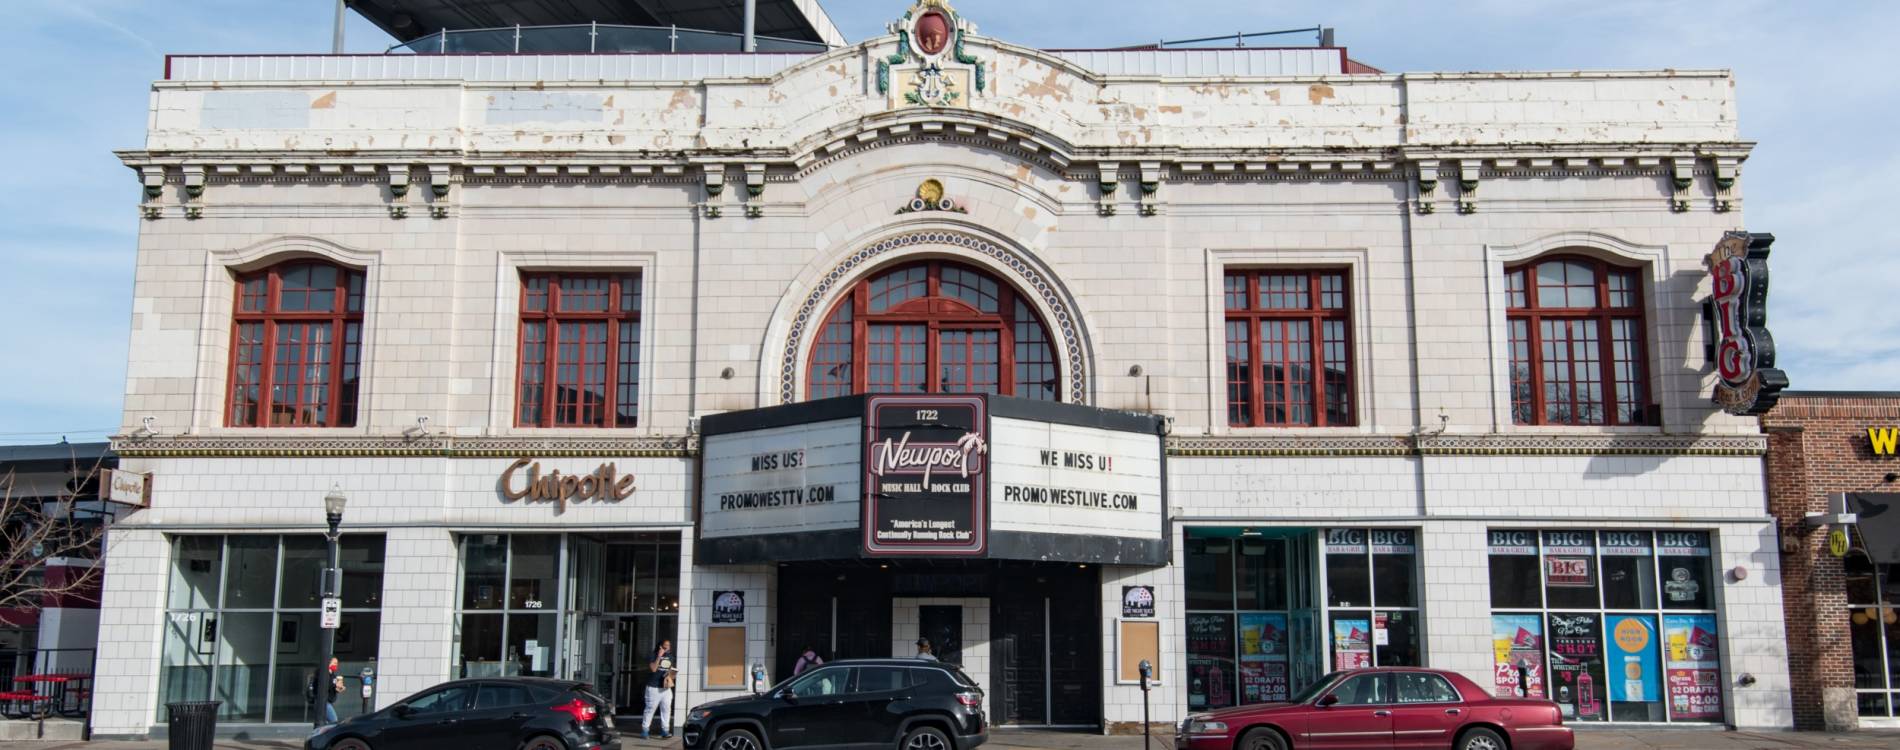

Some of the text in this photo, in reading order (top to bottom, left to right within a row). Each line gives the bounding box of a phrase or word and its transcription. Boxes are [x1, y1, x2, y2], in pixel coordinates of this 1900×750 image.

[1713, 260, 1744, 380] BIG
[916, 410, 938, 420] 1722
[752, 452, 804, 471] MISS US?
[878, 431, 987, 490] Newport
[1040, 449, 1112, 471] WE MISS U!
[114, 476, 142, 496] Chipotle
[502, 457, 637, 514] Chipotle
[882, 483, 970, 493] MUSIC HALL ROCK CLUB
[720, 485, 835, 510] PROMOWESTTV.COM
[929, 520, 955, 530] Longest
[939, 531, 955, 539] Rock
[1374, 531, 1408, 545] BIG
[1492, 532, 1526, 546] BIG
[1549, 532, 1583, 546] BIG
[1606, 532, 1640, 546] BIG
[1664, 533, 1698, 546] BIG
[1553, 561, 1584, 574] BIG
[525, 600, 542, 608] 1726
[170, 613, 197, 622] 1726
[1556, 644, 1596, 653] SHOT
[1260, 685, 1286, 693] $2.00
[1683, 686, 1718, 694] DRAFTS
[1690, 695, 1719, 705] $2.00
